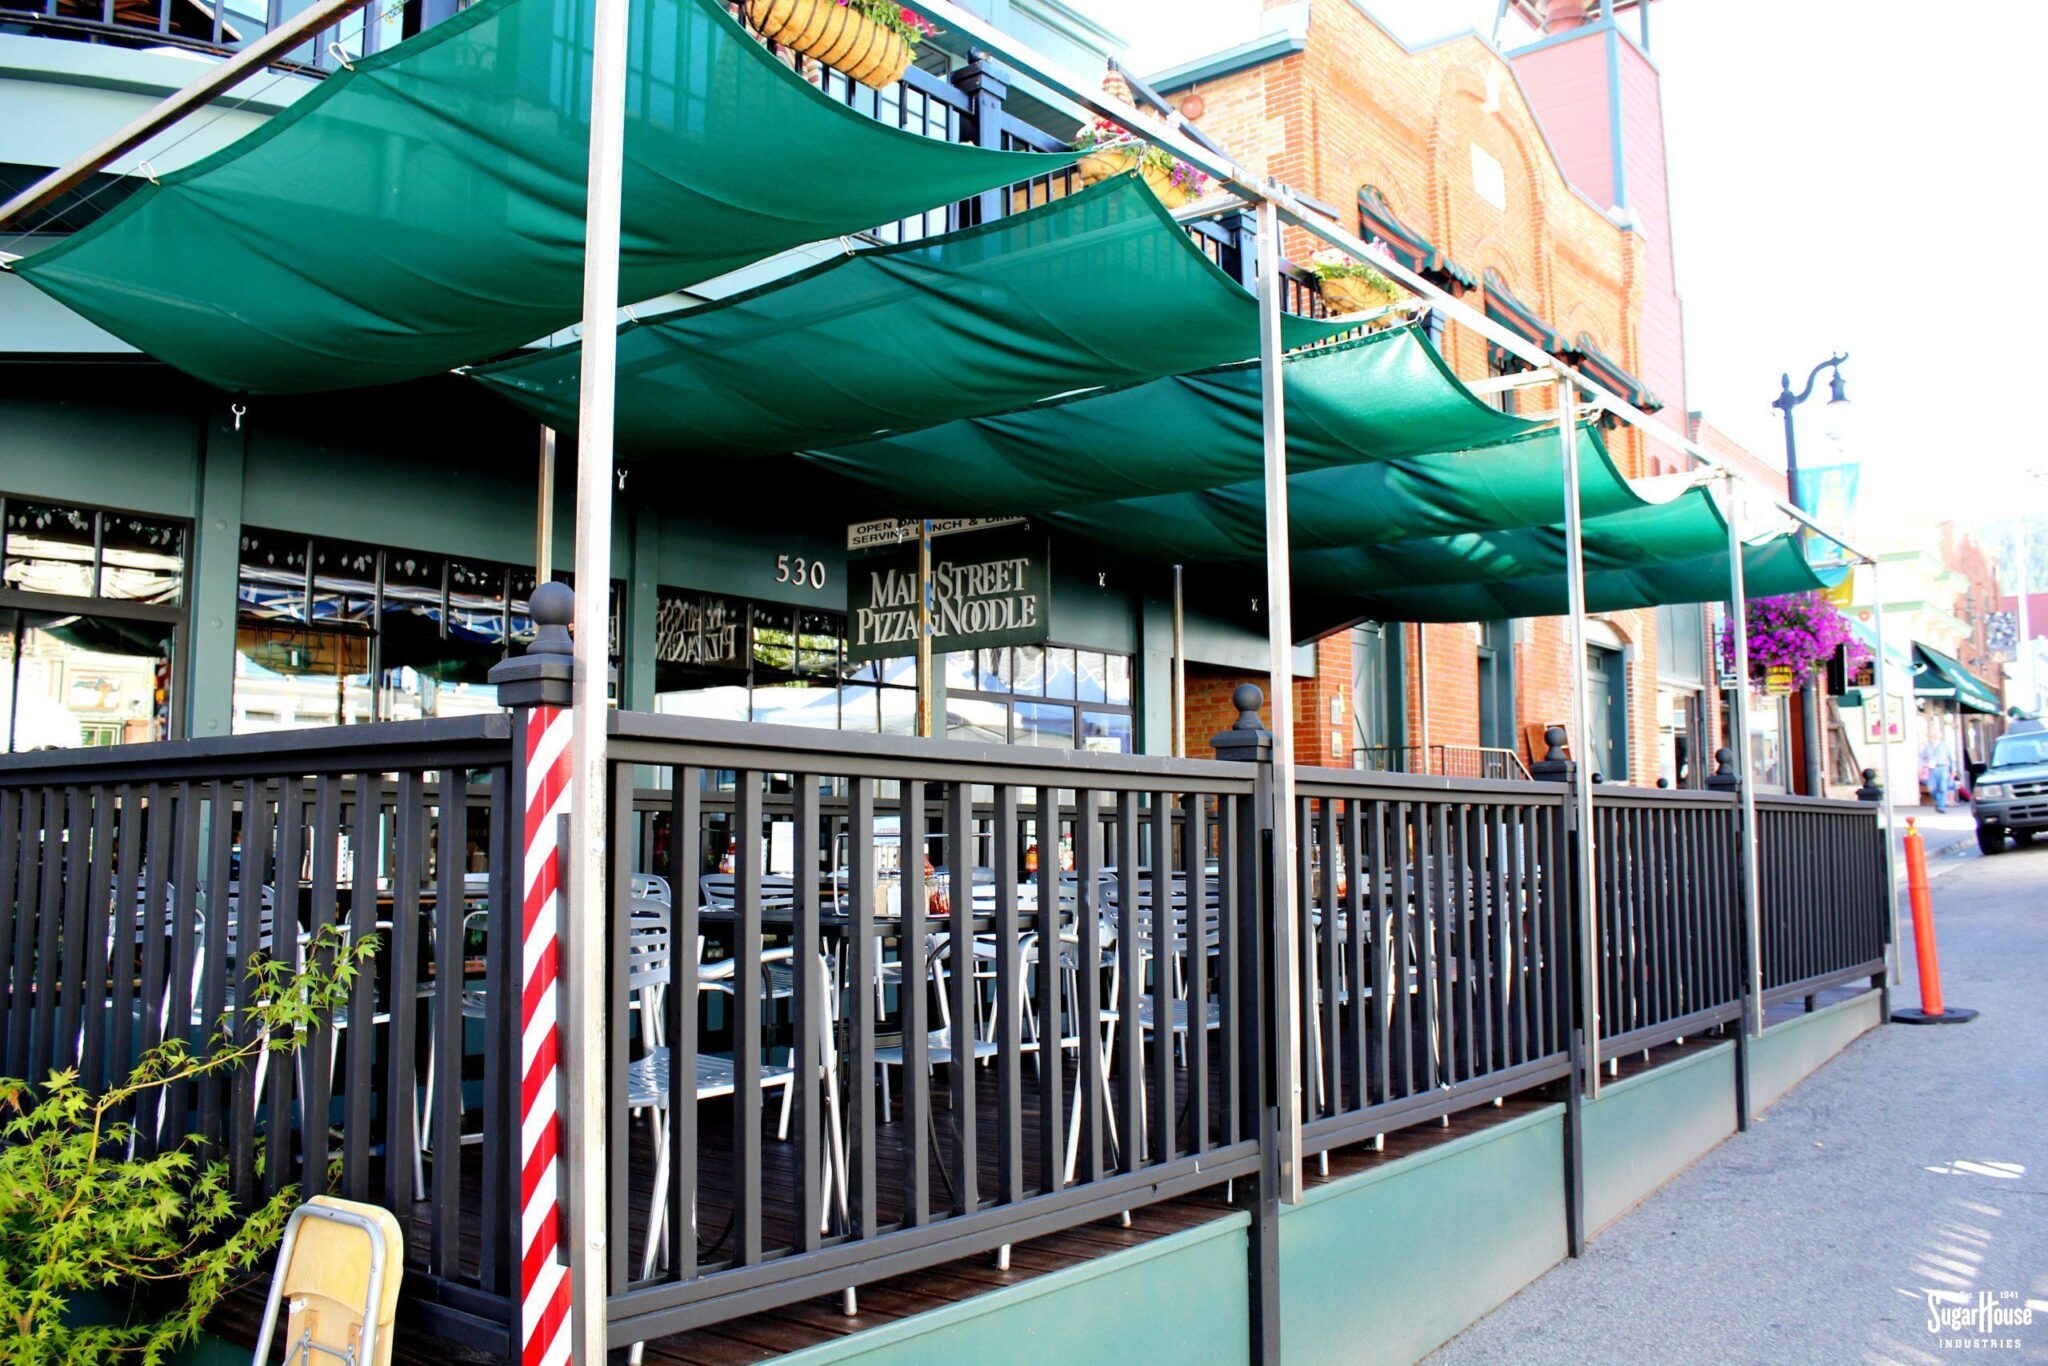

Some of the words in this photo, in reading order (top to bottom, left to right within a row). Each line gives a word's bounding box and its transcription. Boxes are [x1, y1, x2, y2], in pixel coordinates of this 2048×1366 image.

[853, 528, 910, 545] SERVING
[915, 519, 962, 535] LNCH
[857, 521, 892, 534] OPEN
[775, 554, 826, 590] 530
[936, 558, 1029, 601] STREET
[856, 608, 919, 646] PIZZA
[937, 595, 1037, 636] NOODLE
